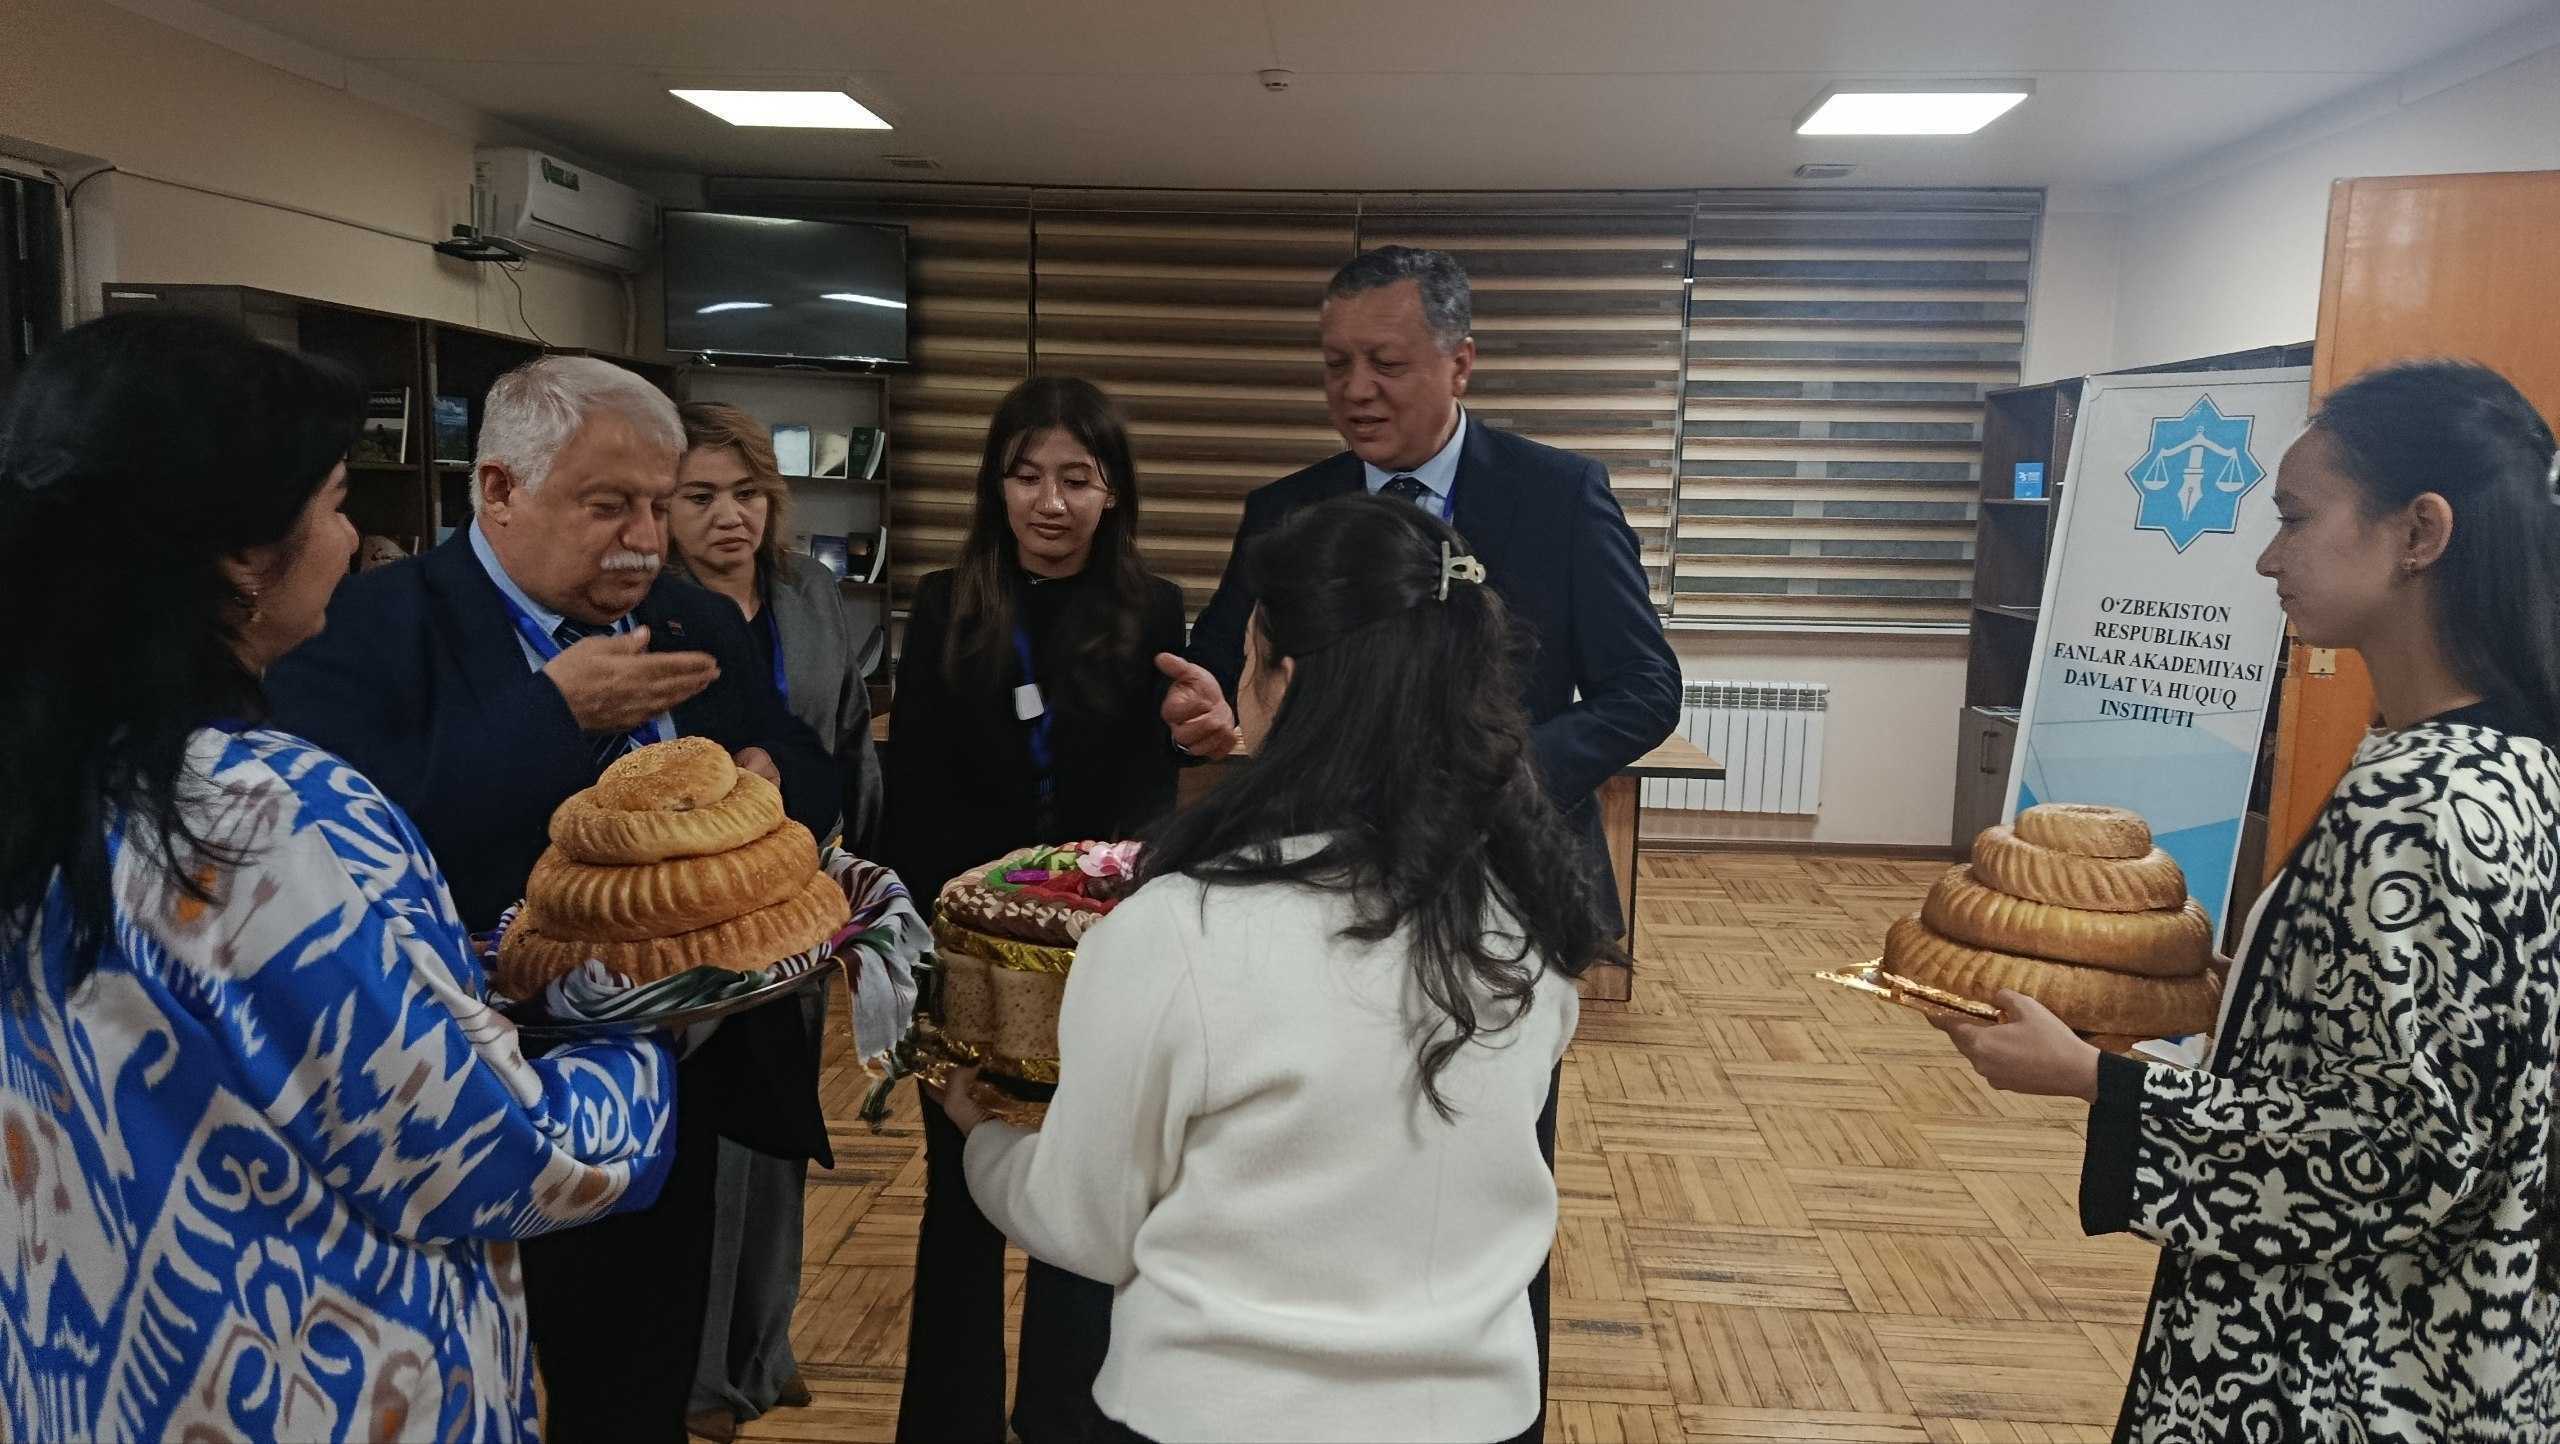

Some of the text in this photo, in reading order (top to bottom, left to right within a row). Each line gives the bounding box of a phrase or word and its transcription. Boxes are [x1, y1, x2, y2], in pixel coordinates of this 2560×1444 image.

[2094, 621, 2232, 650] RESPUBLIKASI
[2054, 643, 2264, 682] FANLAR AKADEMIYASI
[2064, 669, 2237, 710] DAVLAT VA HUQUQ
[2099, 699, 2194, 728] INSTITUTI
